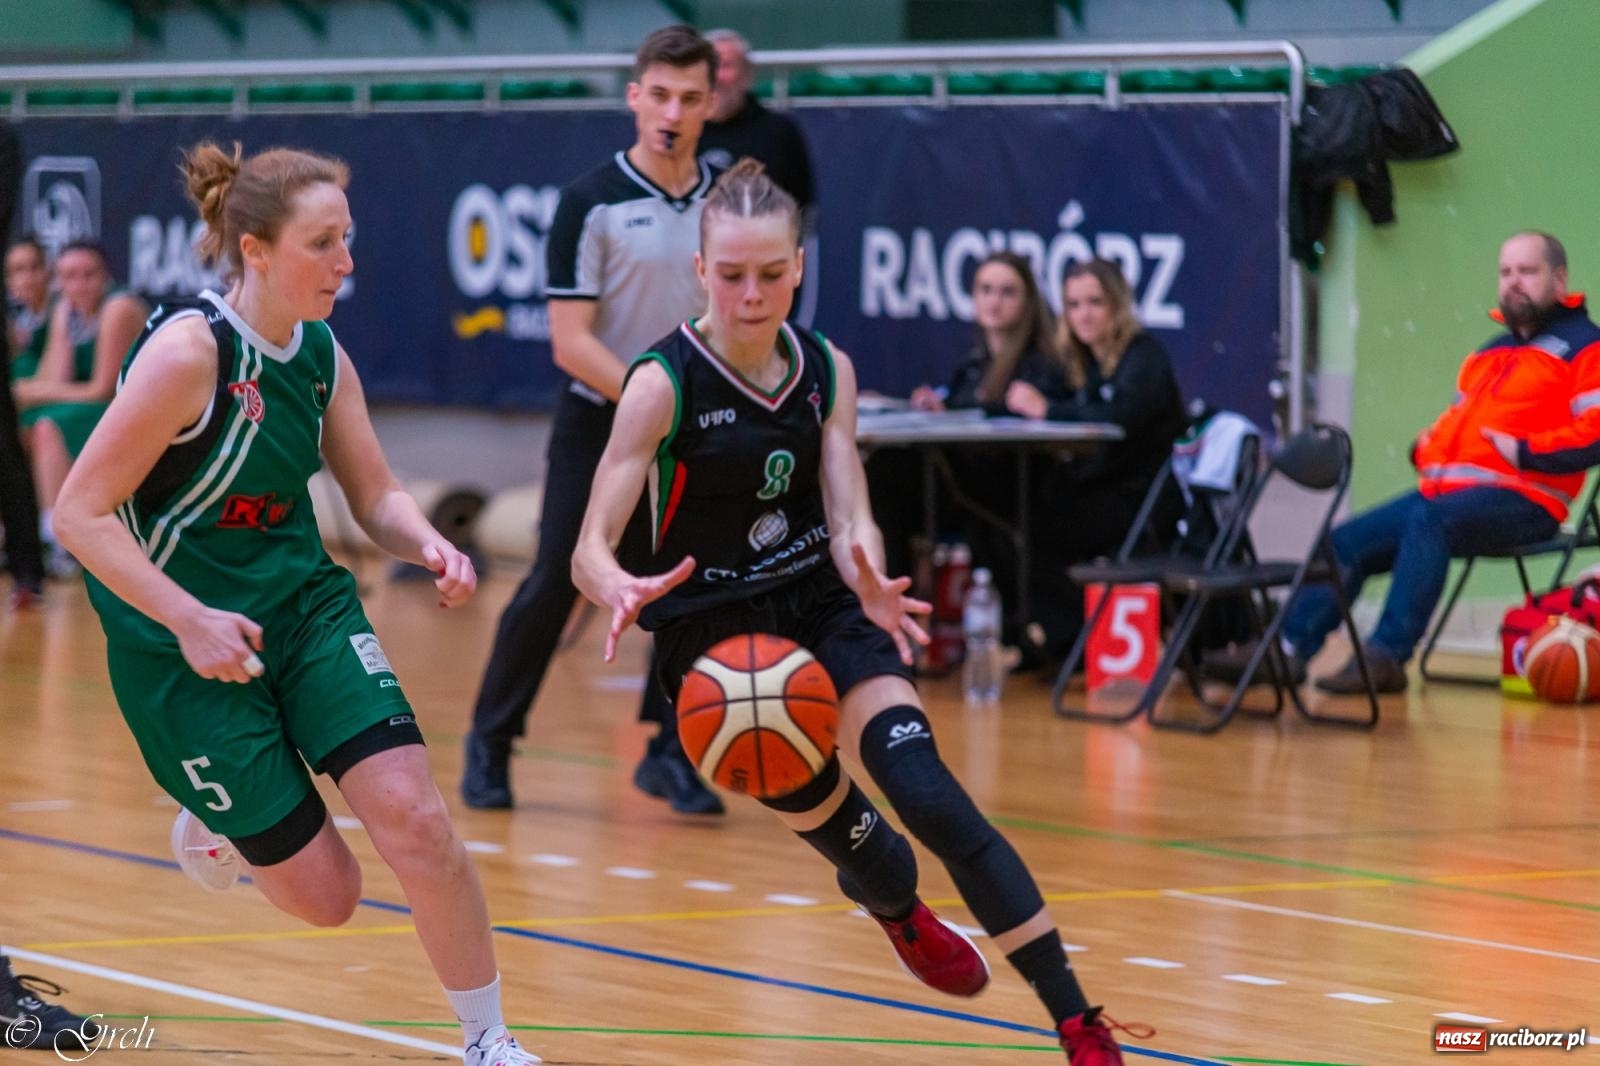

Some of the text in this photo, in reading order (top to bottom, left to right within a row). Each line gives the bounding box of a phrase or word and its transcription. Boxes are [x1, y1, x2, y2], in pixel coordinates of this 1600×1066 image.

[756, 449, 796, 500] 8
[1097, 595, 1148, 676] 5
[181, 755, 233, 812] 5
